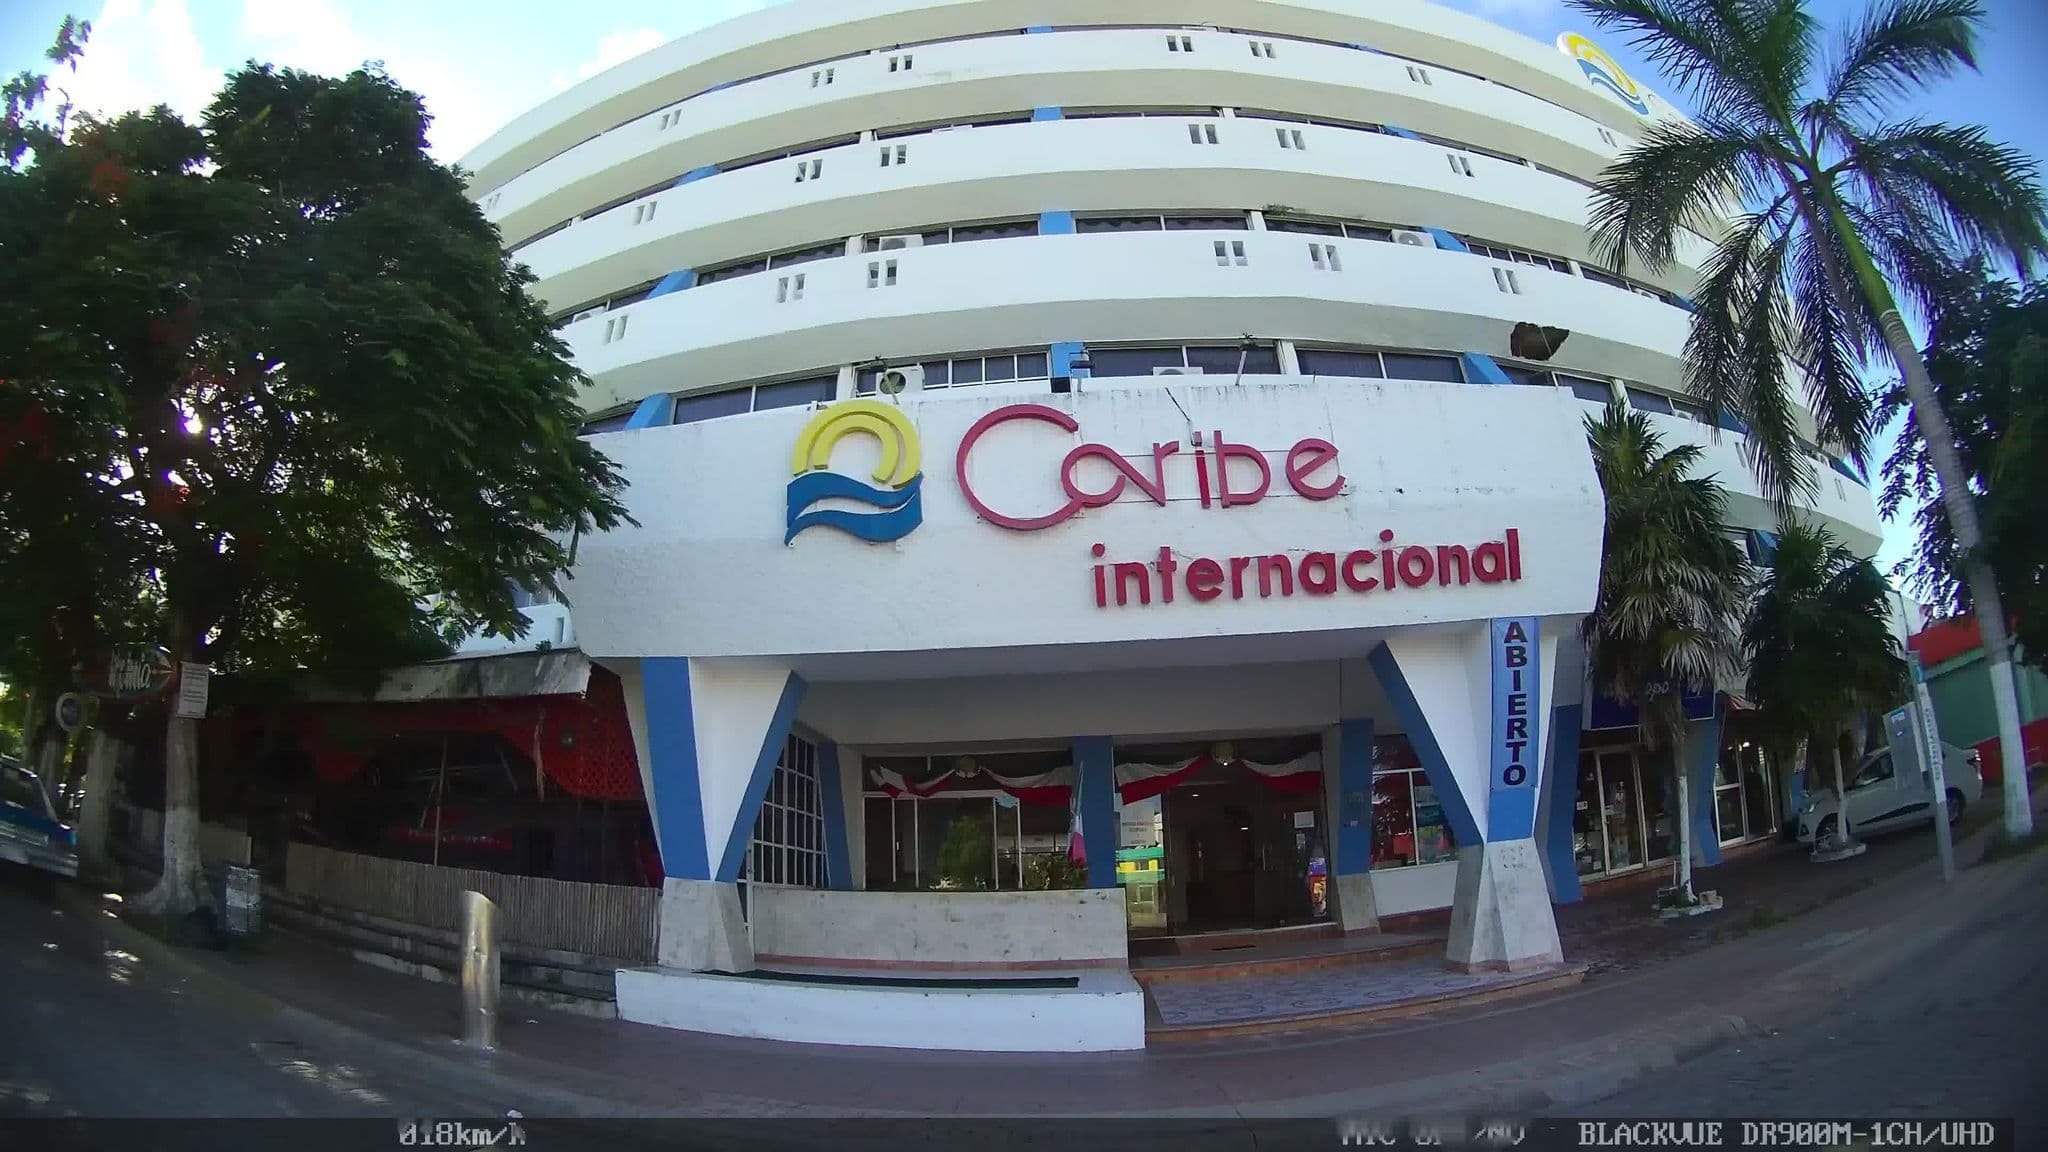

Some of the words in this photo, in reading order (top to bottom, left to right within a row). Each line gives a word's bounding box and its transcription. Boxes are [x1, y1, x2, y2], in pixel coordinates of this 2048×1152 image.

[956, 403, 1346, 531] Caribe
[1091, 528, 1522, 608] internacional
[1503, 621, 1528, 786] ABIERTO
